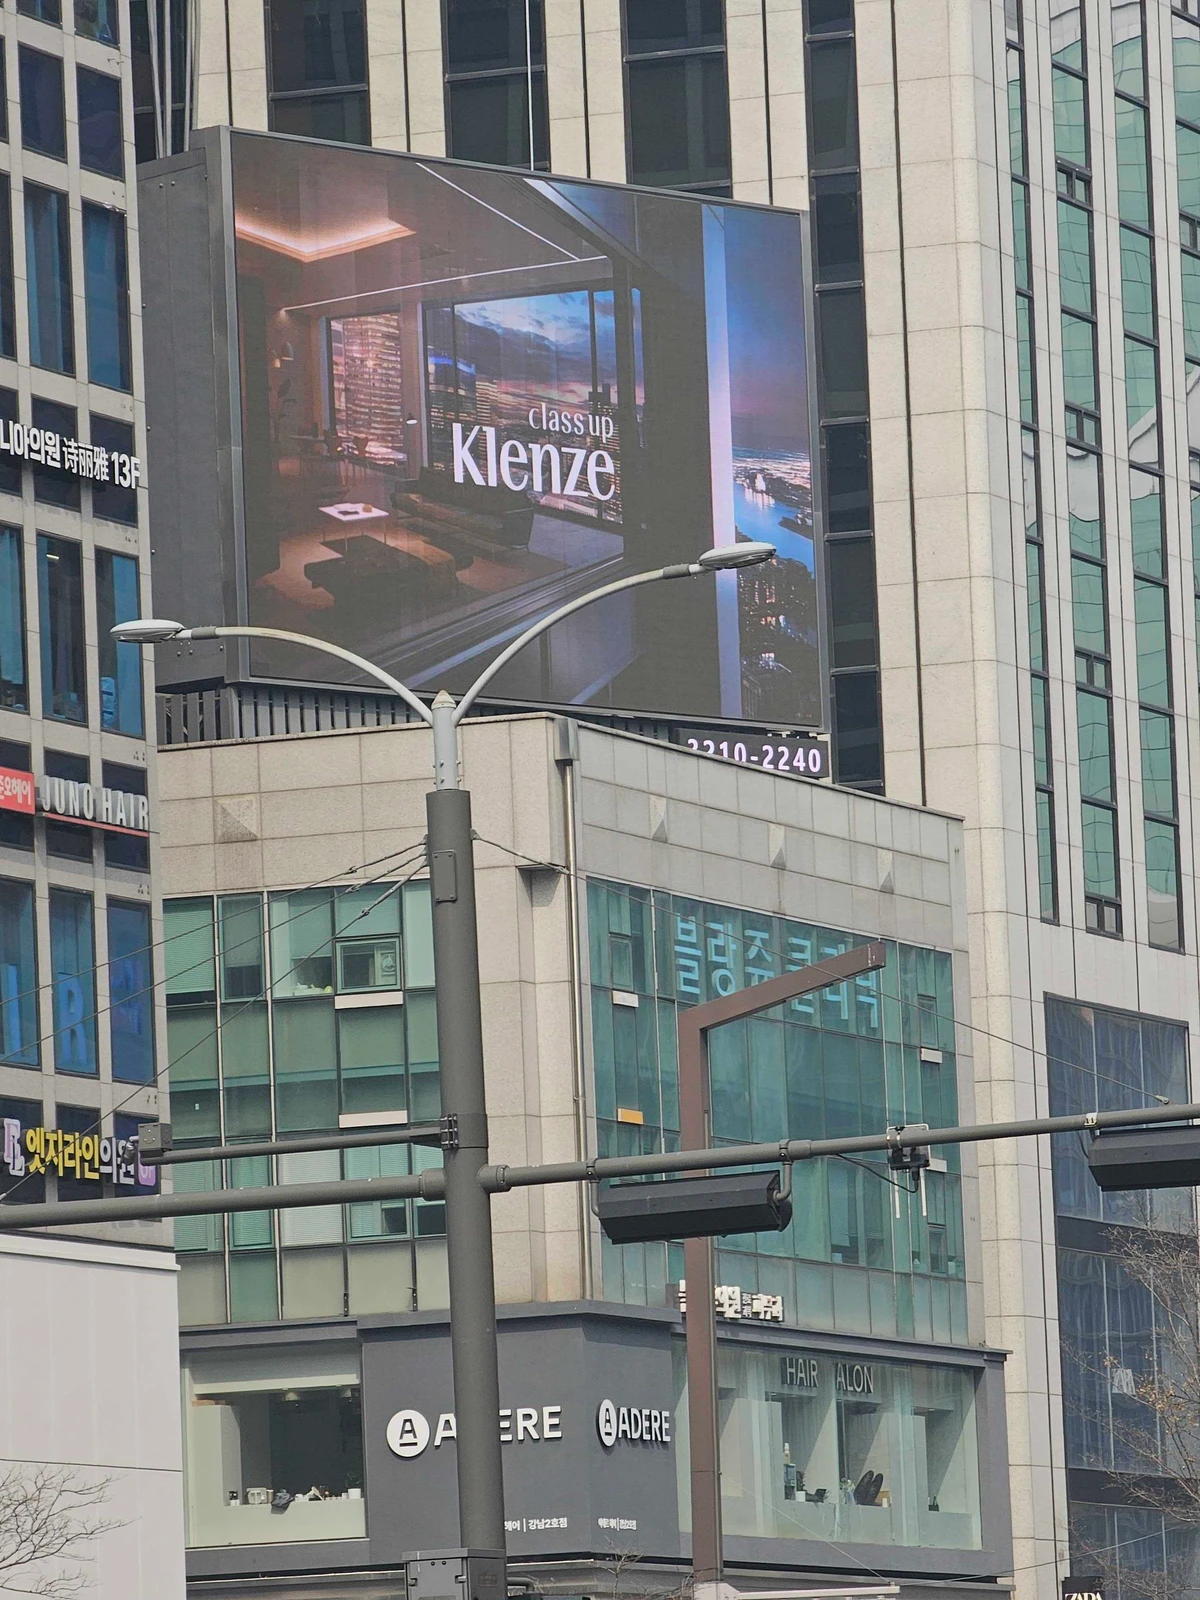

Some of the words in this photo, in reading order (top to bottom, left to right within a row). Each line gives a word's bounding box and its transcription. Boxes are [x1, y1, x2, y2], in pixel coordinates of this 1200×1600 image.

[528, 402, 584, 435] class
[588, 414, 614, 443] up
[111, 451, 141, 489] 13F
[452, 422, 616, 501] Klenze
[41, 775, 94, 820] JUNO
[99, 787, 149, 831] HAIR
[785, 1357, 819, 1387] HAIR
[434, 1405, 563, 1447] AERE
[618, 1406, 671, 1442] ADERE
